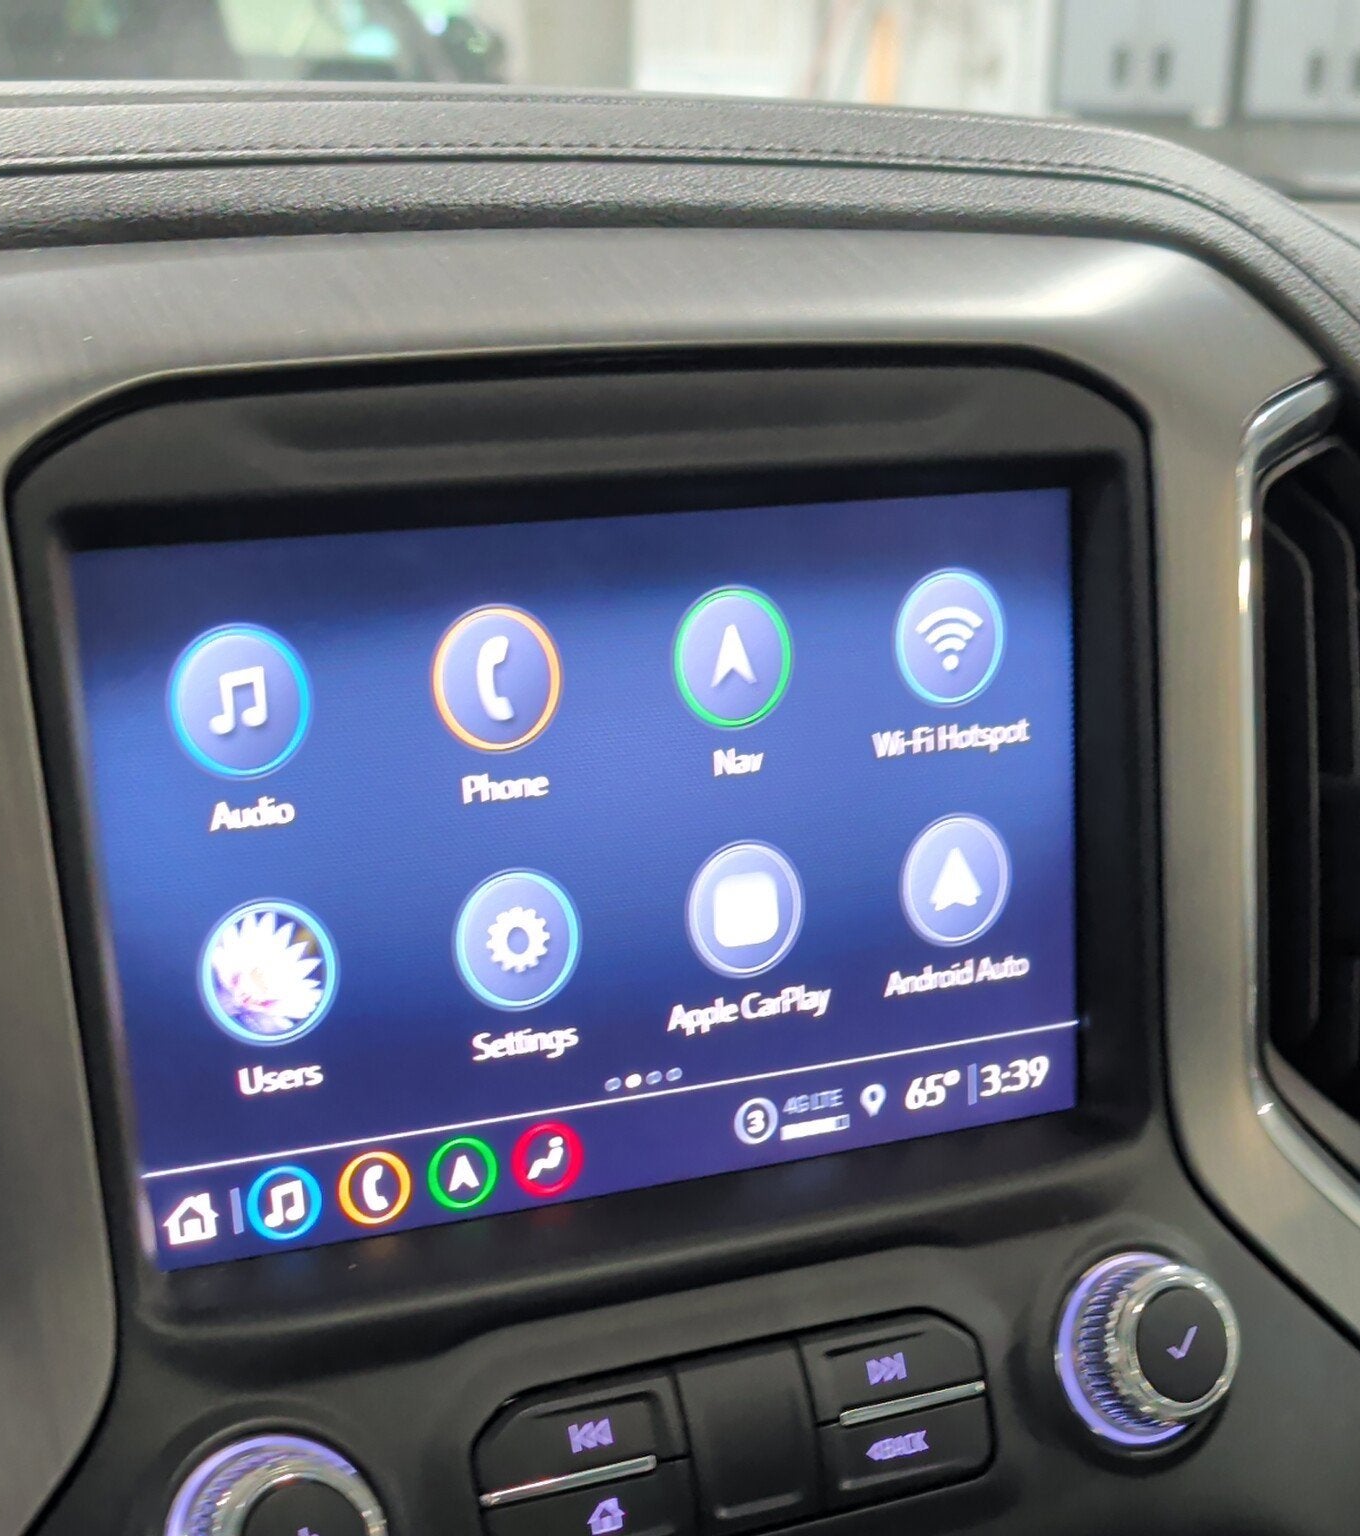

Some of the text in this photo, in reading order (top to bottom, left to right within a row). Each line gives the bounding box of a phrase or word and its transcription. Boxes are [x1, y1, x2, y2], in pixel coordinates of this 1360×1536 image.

[871, 718, 1031, 759] Wi-Fi Hotspot
[712, 748, 764, 777] Nav
[460, 773, 550, 804] Phone
[208, 796, 296, 833] Audio
[883, 955, 1031, 998] Android Auto
[666, 984, 832, 1037] Apple CarPlay
[471, 1027, 580, 1062] Settings
[236, 1064, 324, 1096] Users
[979, 1055, 1050, 1098] 3:39
